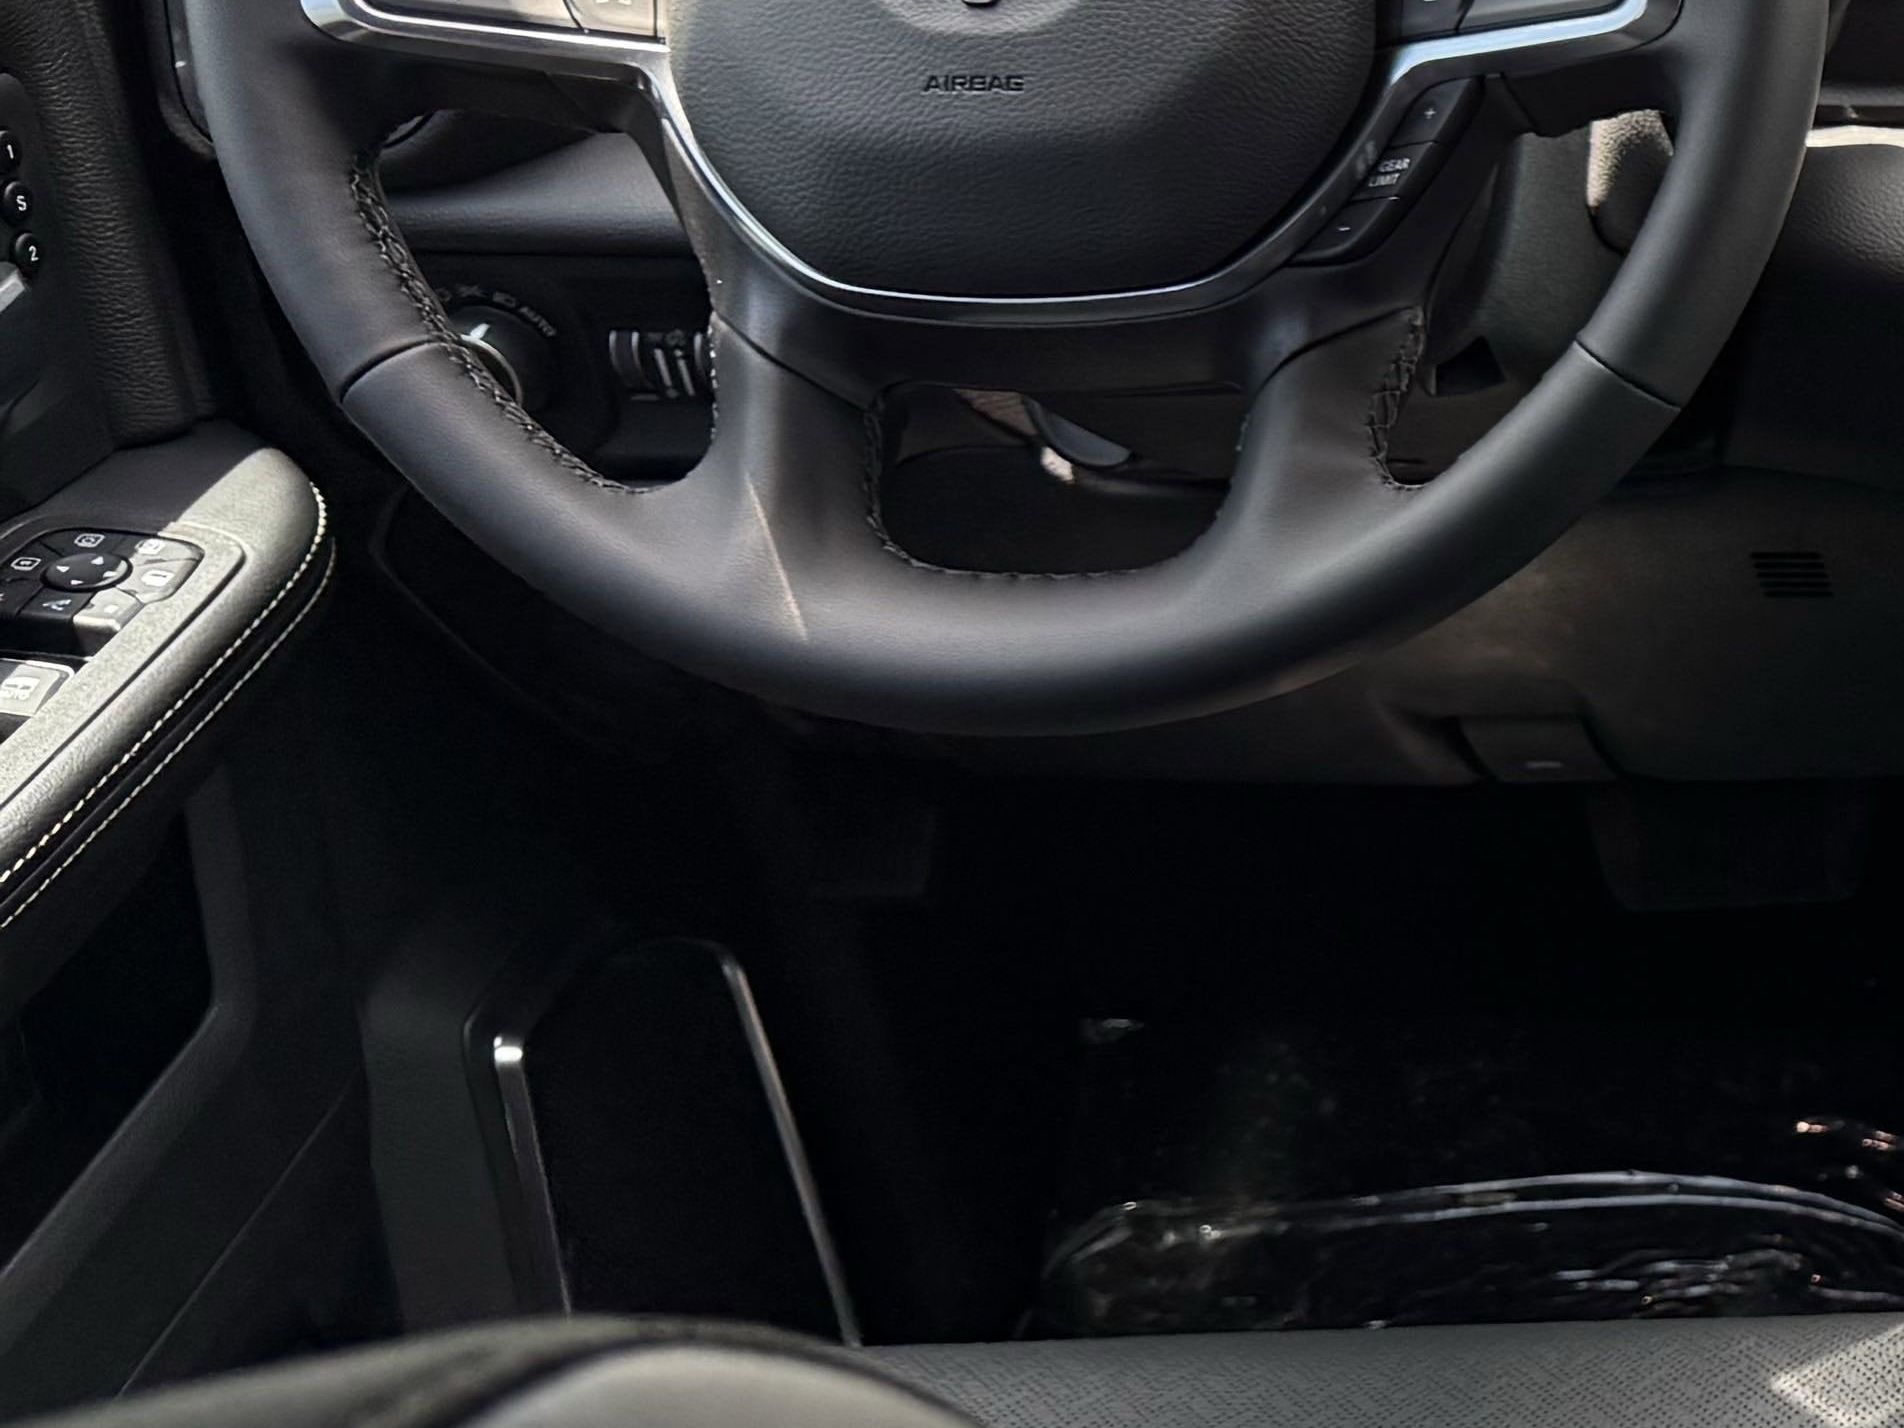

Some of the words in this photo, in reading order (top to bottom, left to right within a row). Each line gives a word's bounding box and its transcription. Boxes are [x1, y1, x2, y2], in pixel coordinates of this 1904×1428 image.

[922, 74, 1025, 94] AIRBAG
[1378, 157, 1411, 173] GEAR
[1367, 172, 1401, 188] LIMIT
[15, 194, 28, 212] S
[28, 245, 40, 262] 2
